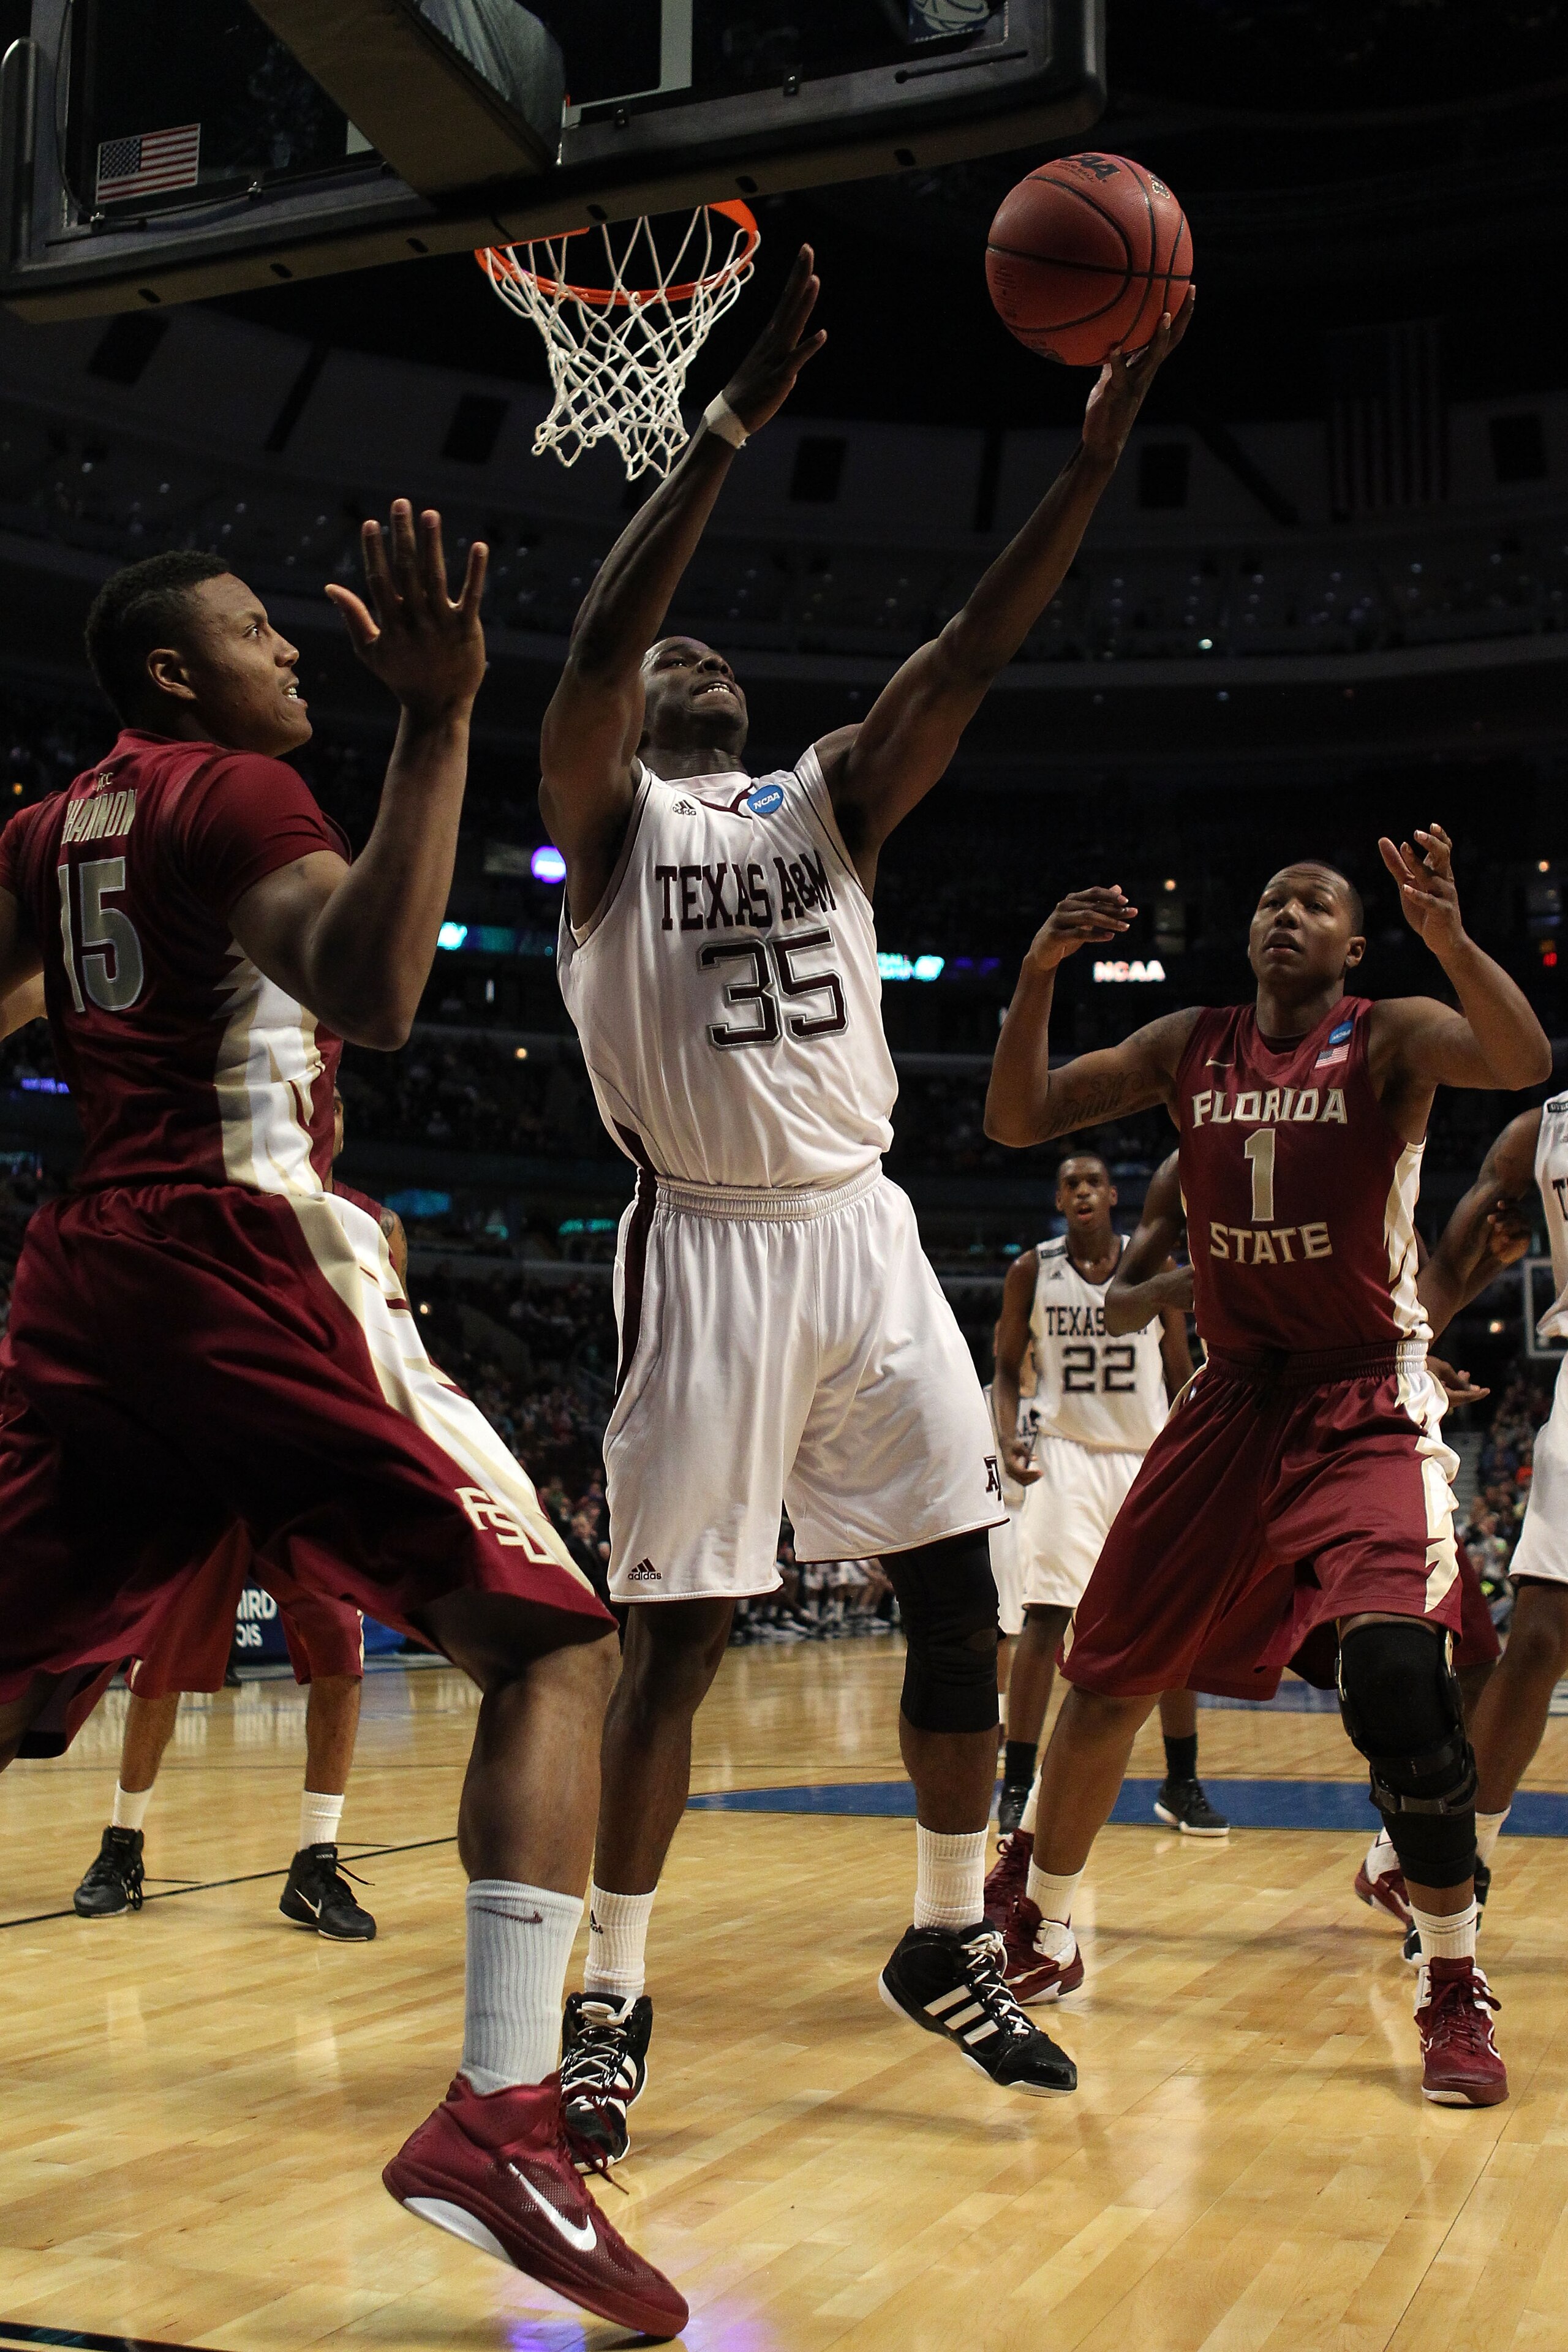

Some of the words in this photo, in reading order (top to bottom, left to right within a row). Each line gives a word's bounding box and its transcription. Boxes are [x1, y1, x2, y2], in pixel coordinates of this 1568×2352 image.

[61, 788, 137, 844] HANNON
[753, 792, 781, 810] NCAA
[655, 862, 772, 930] TEXAS
[773, 850, 837, 921] A&M
[58, 856, 144, 1012] 15
[696, 927, 849, 1051] 35
[1093, 960, 1166, 982] NCAA
[1192, 1087, 1348, 1128] FLORIDA
[1244, 1127, 1276, 1221] 1
[1209, 1221, 1333, 1265] STATE
[1046, 1306, 1106, 1336] TEXAS
[1064, 1346, 1136, 1392] 22
[627, 1571, 662, 1580] adidas
